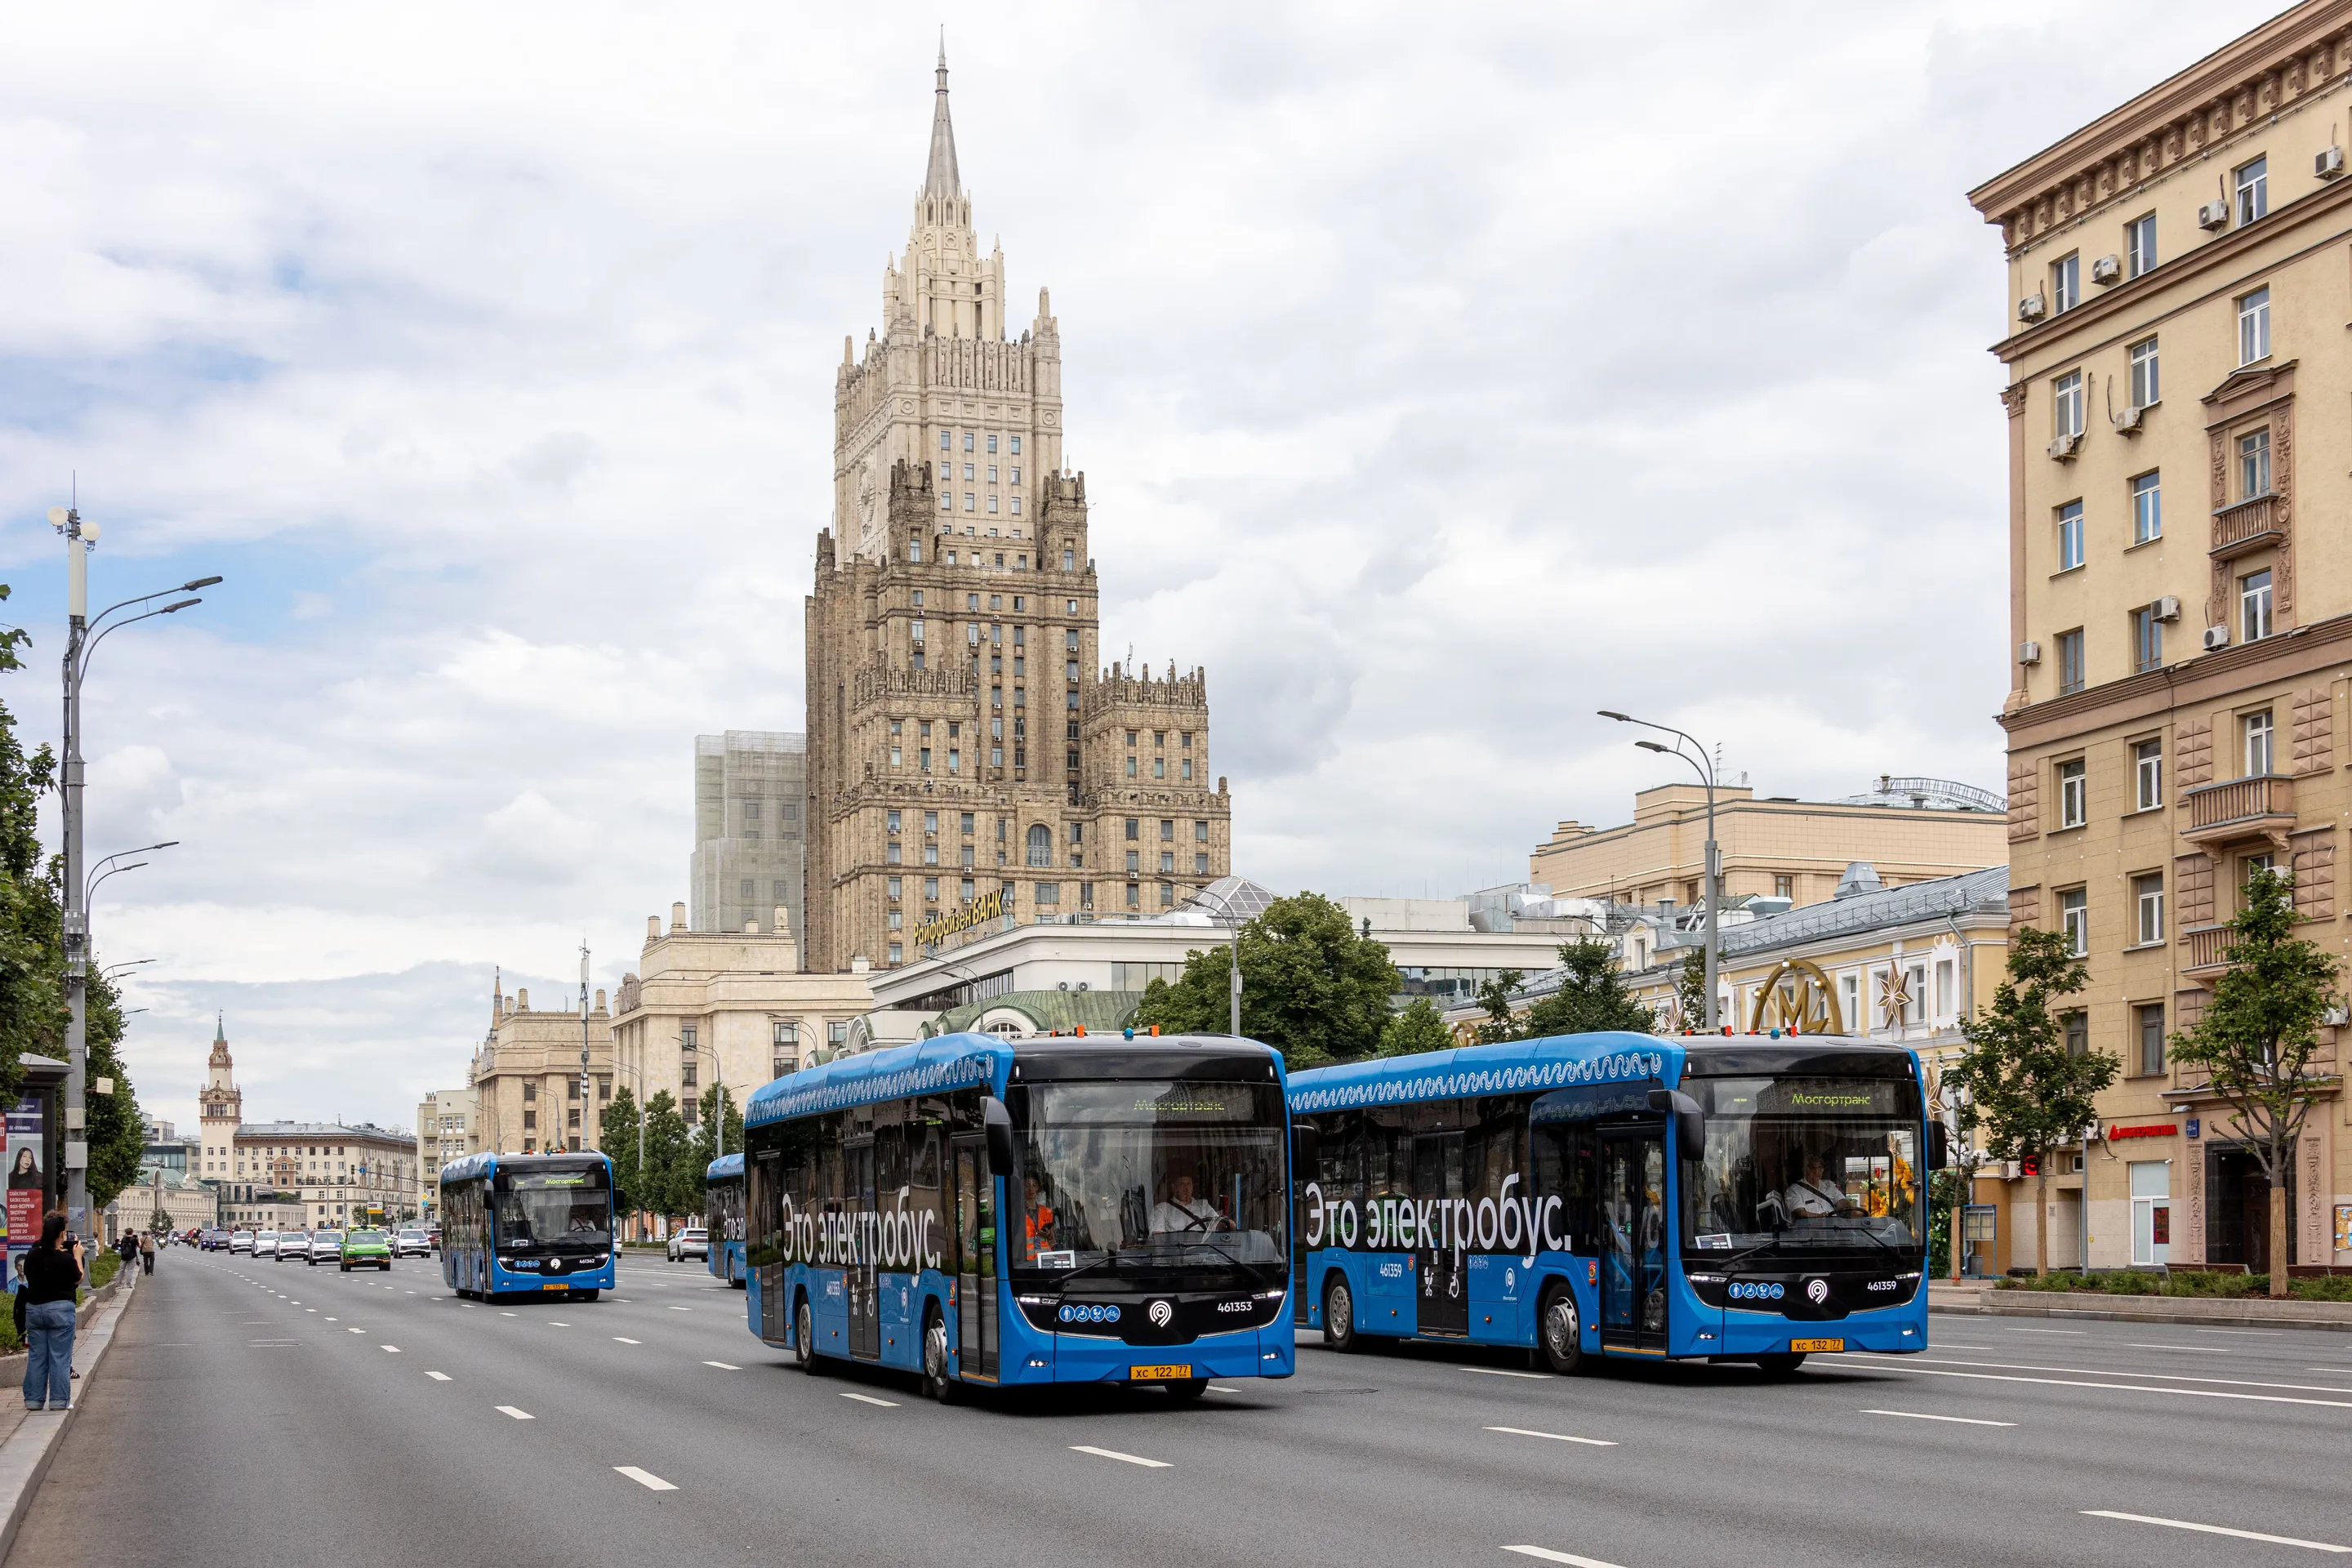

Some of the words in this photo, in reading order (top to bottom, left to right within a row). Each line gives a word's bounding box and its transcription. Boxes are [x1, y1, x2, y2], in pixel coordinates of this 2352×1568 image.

[914, 908, 973, 947] Райффайзен
[973, 888, 1004, 924] БАНК
[1791, 1093, 1871, 1107] Мосгортранс
[723, 1209, 736, 1241] Это
[1305, 1183, 1358, 1248] Это
[1366, 1172, 1571, 1269] электробус.
[782, 1193, 814, 1263] Это
[817, 1185, 941, 1288] электробус.
[1379, 1263, 1402, 1277] 461359
[826, 1281, 840, 1296] 461353
[1867, 1281, 1897, 1290] 461359
[1217, 1301, 1253, 1312] 461353
[1811, 1340, 1827, 1350] 132
[1153, 1367, 1172, 1378] 122
[1178, 1365, 1188, 1374] 77
